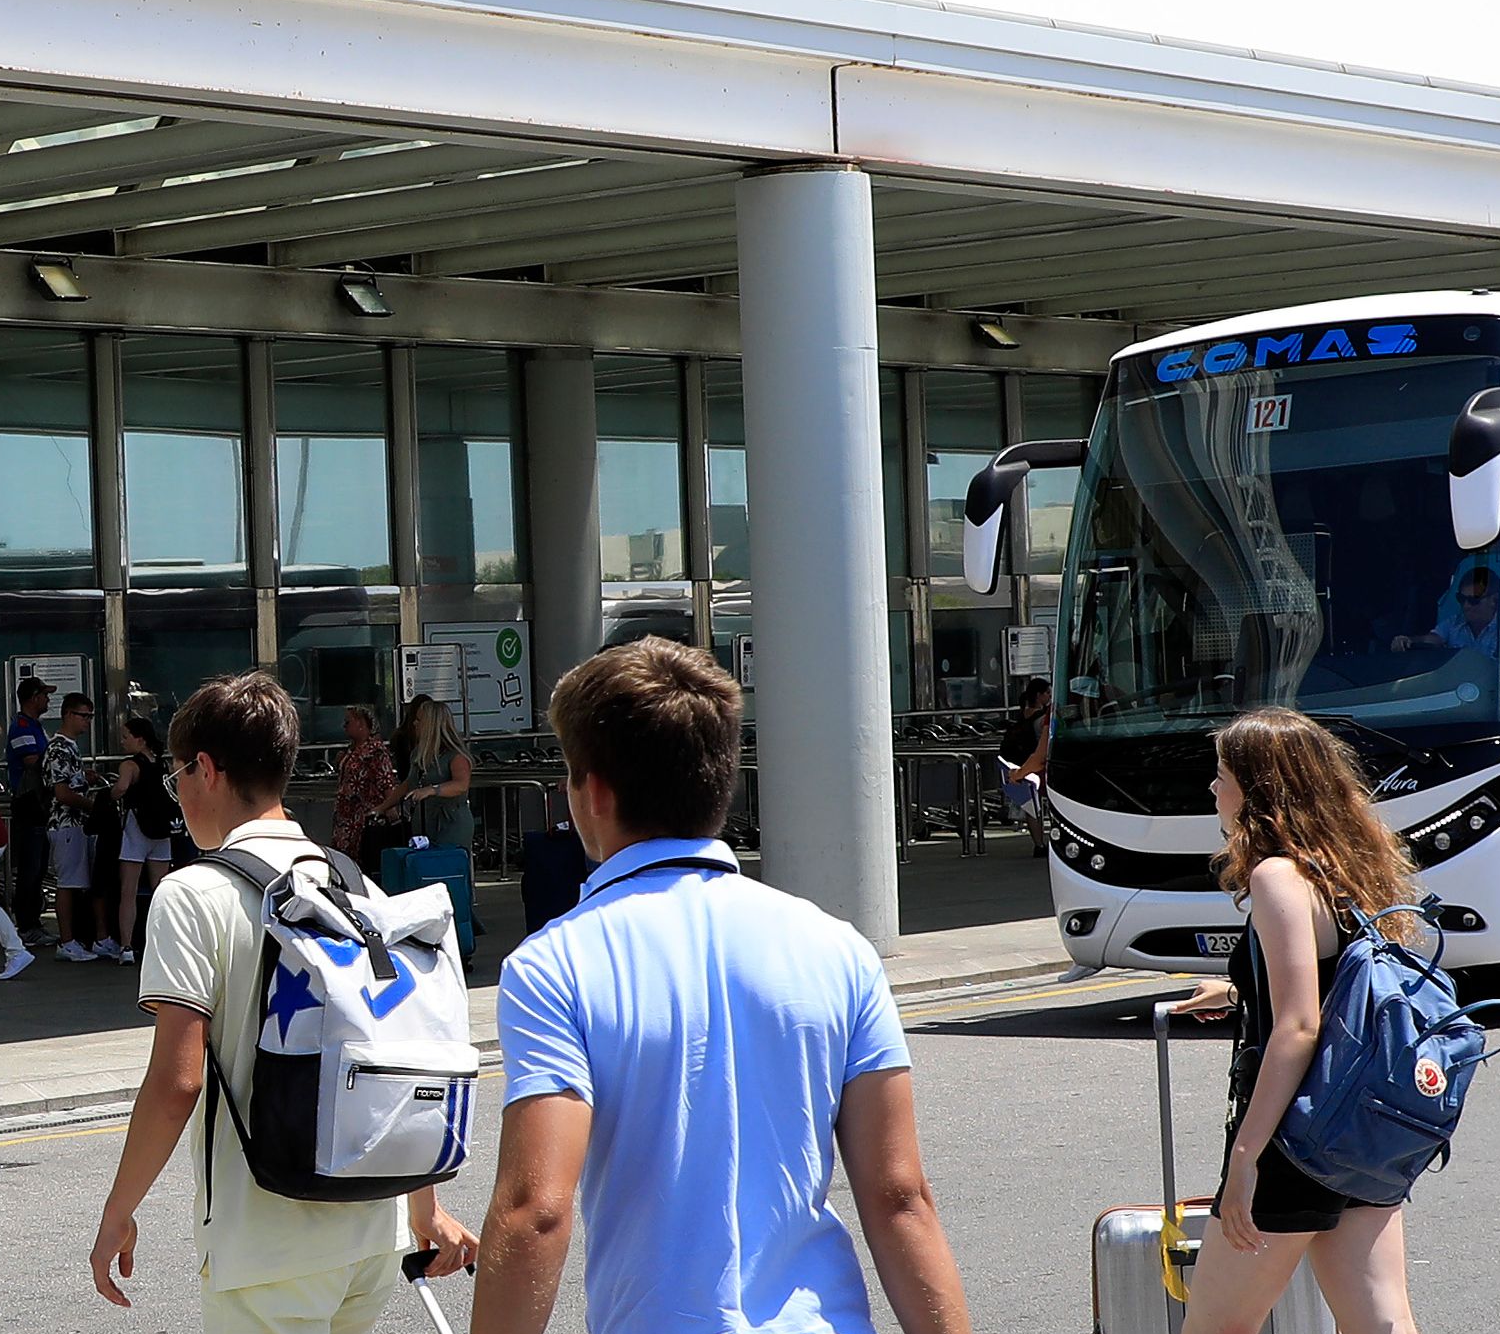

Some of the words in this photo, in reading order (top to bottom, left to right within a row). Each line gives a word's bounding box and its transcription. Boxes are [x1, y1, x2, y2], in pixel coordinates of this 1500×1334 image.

[1156, 324, 1418, 383] COMAS
[1253, 397, 1289, 429] 121
[1371, 765, 1418, 796] Aura
[1208, 936, 1240, 952] 239
